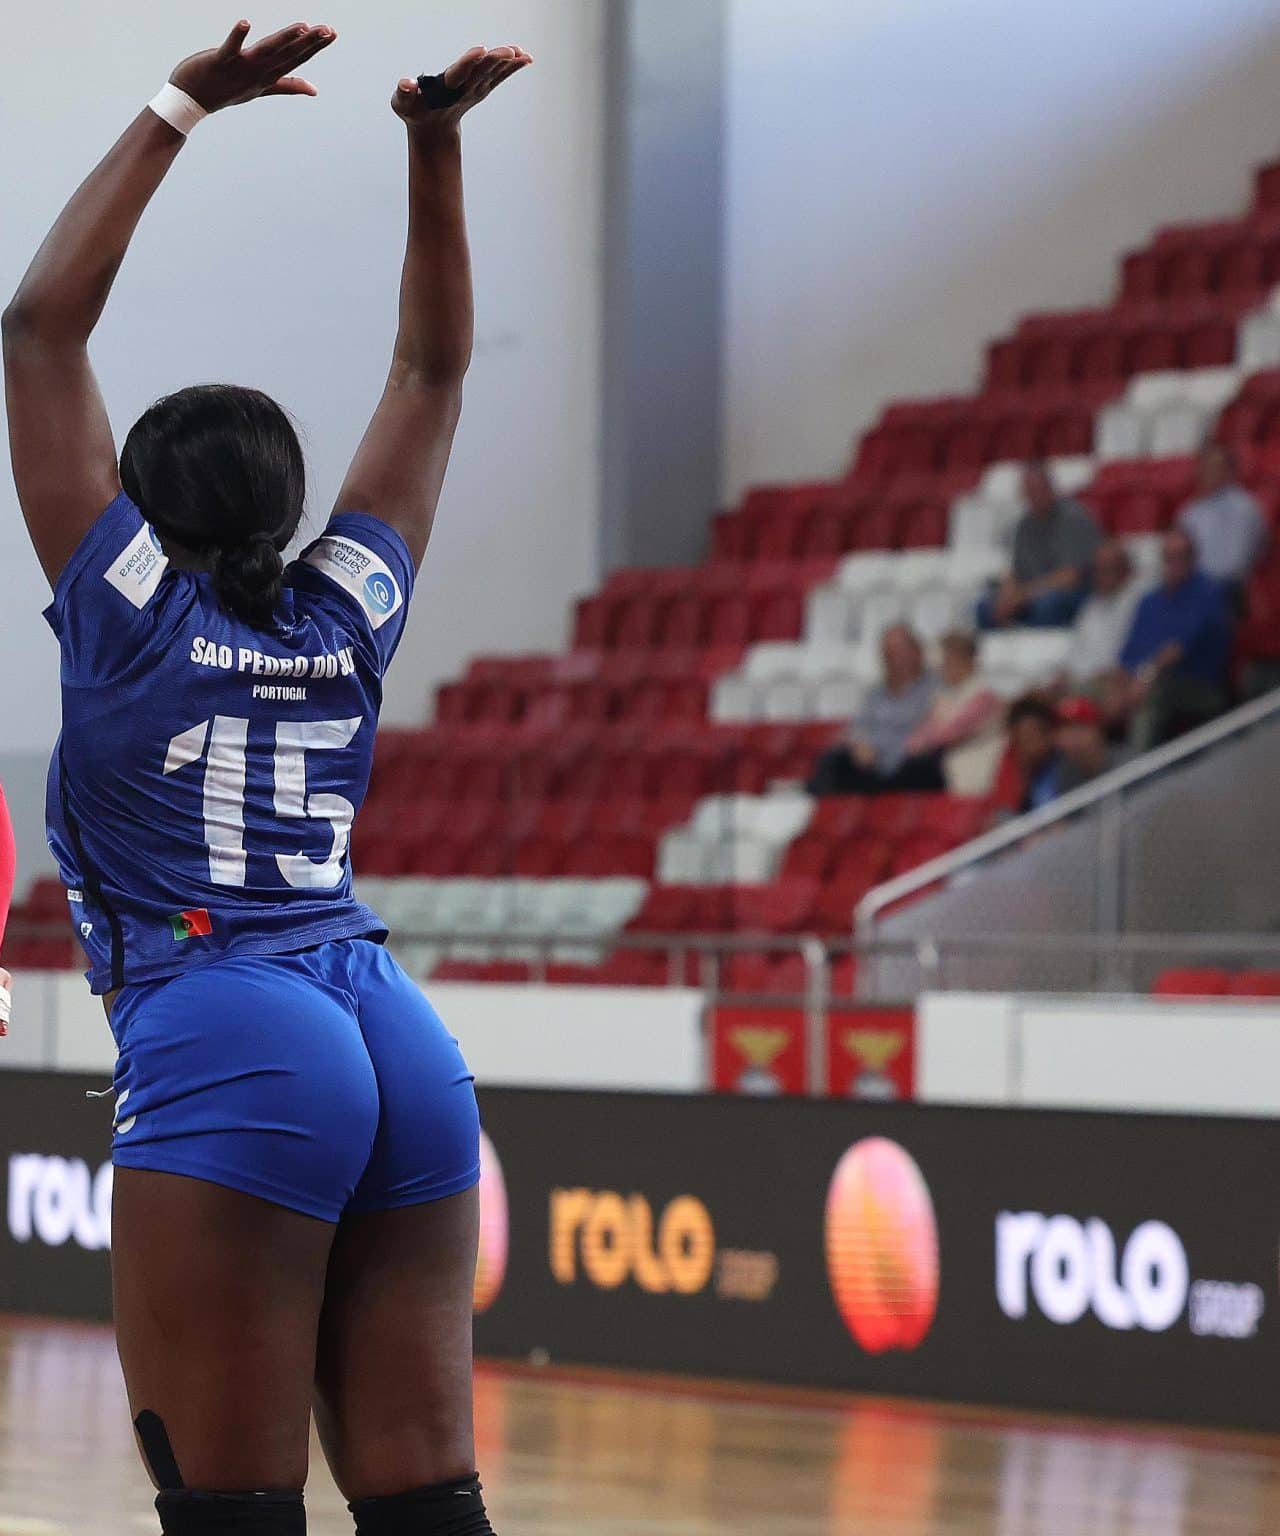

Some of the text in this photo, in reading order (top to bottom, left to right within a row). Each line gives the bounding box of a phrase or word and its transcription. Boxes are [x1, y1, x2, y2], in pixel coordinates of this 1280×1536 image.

[190, 636, 233, 669] SAO
[238, 648, 309, 678] PEDRO
[310, 655, 338, 679] DO
[252, 684, 307, 701] PORTUGAL
[162, 715, 363, 889] 15
